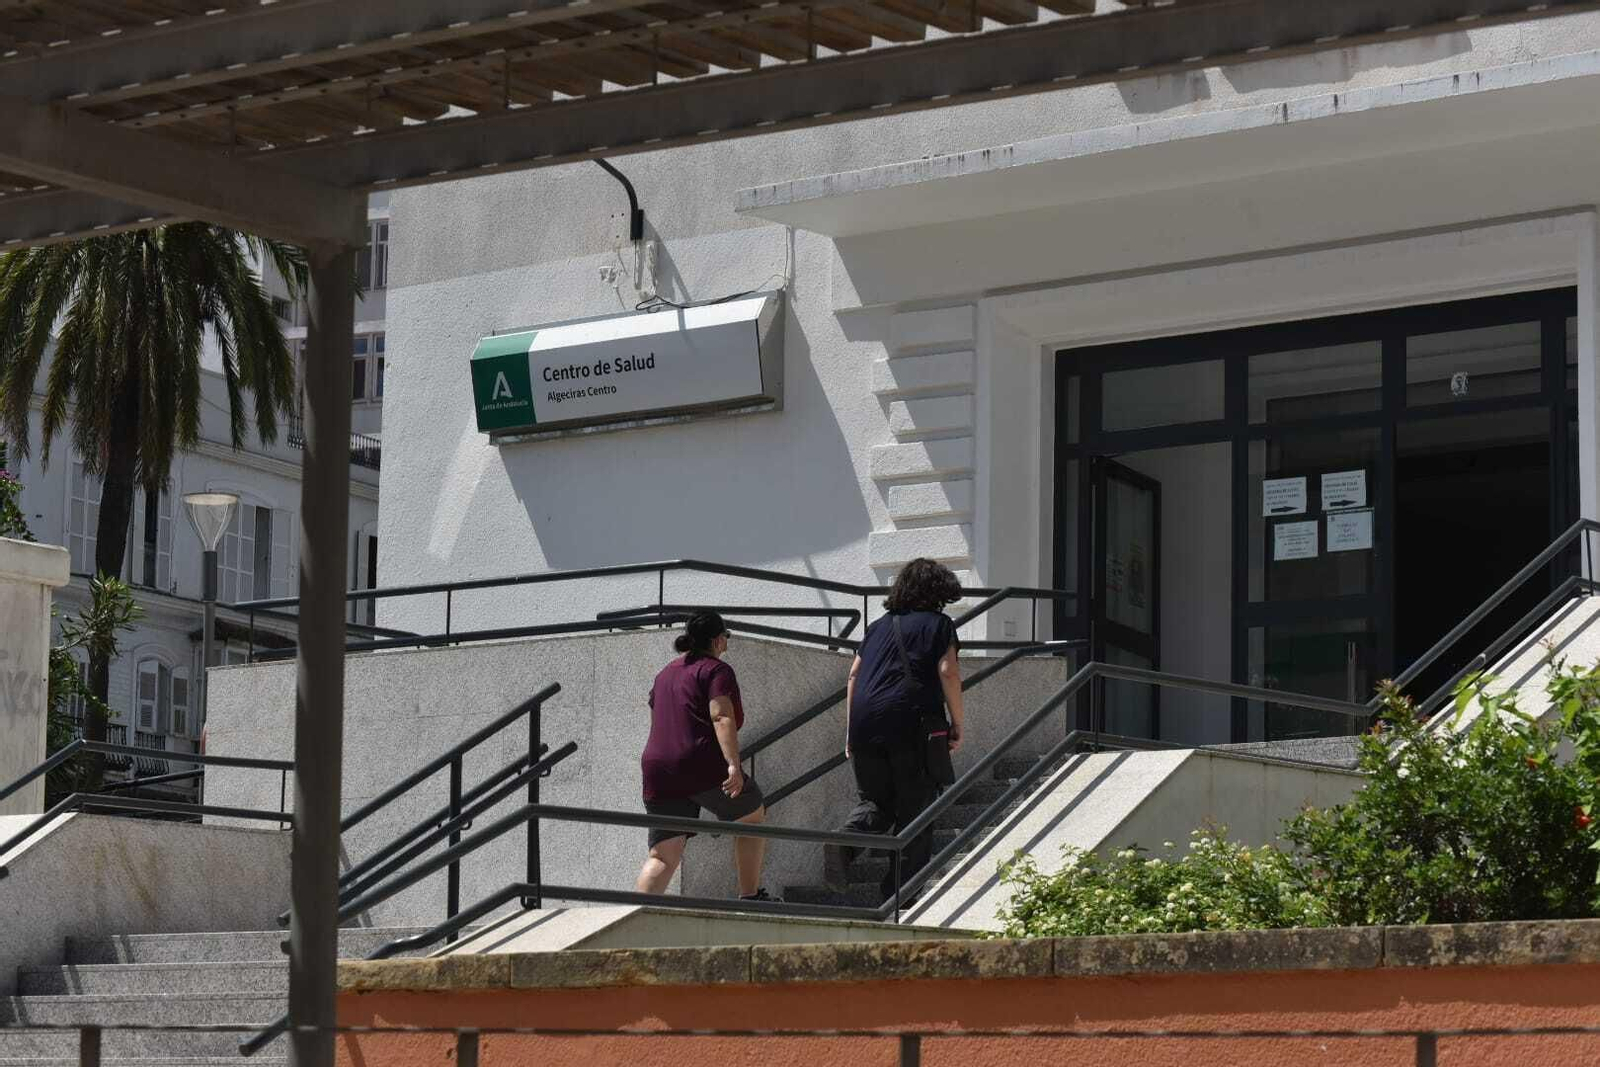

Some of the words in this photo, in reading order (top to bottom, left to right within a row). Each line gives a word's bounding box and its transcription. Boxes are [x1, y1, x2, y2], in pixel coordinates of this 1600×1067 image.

[543, 363, 590, 382] Centro
[594, 359, 611, 376] de
[614, 353, 656, 373] Salud
[547, 388, 586, 403] Algeciras
[587, 384, 617, 397] Centro
